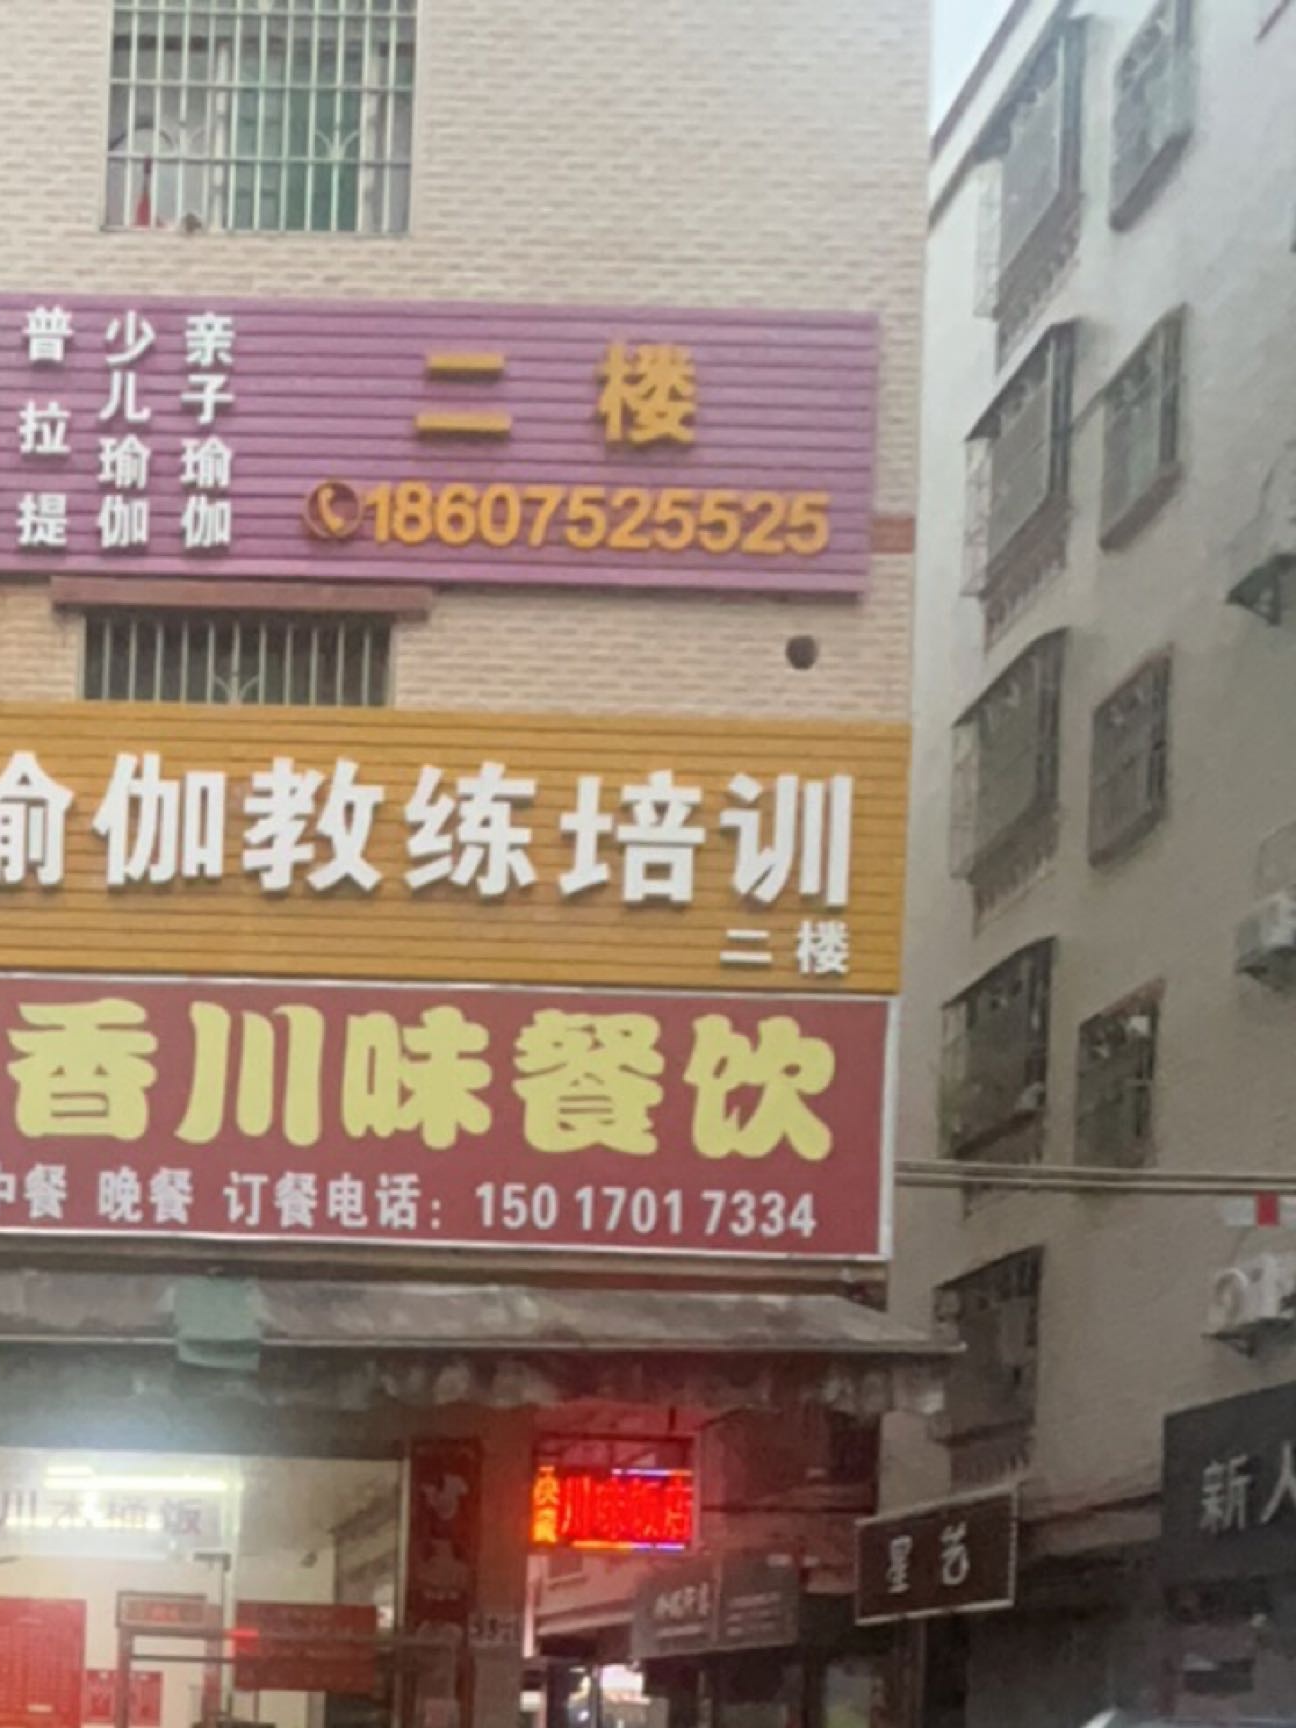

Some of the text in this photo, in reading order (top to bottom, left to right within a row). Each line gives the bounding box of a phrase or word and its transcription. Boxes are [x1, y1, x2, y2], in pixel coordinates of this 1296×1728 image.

[15, 304, 74, 547] 普拉提
[96, 309, 157, 549] 少儿瑜伽
[179, 310, 236, 549] 亲子瑜伽
[415, 340, 698, 447] 二楼
[364, 479, 830, 557] 18607525525
[720, 921, 848, 975] 二楼
[98, 1166, 193, 1223] 晚餐
[474, 1182, 559, 1231] 150
[573, 1185, 684, 1235] 1701
[701, 1190, 817, 1239] 7334
